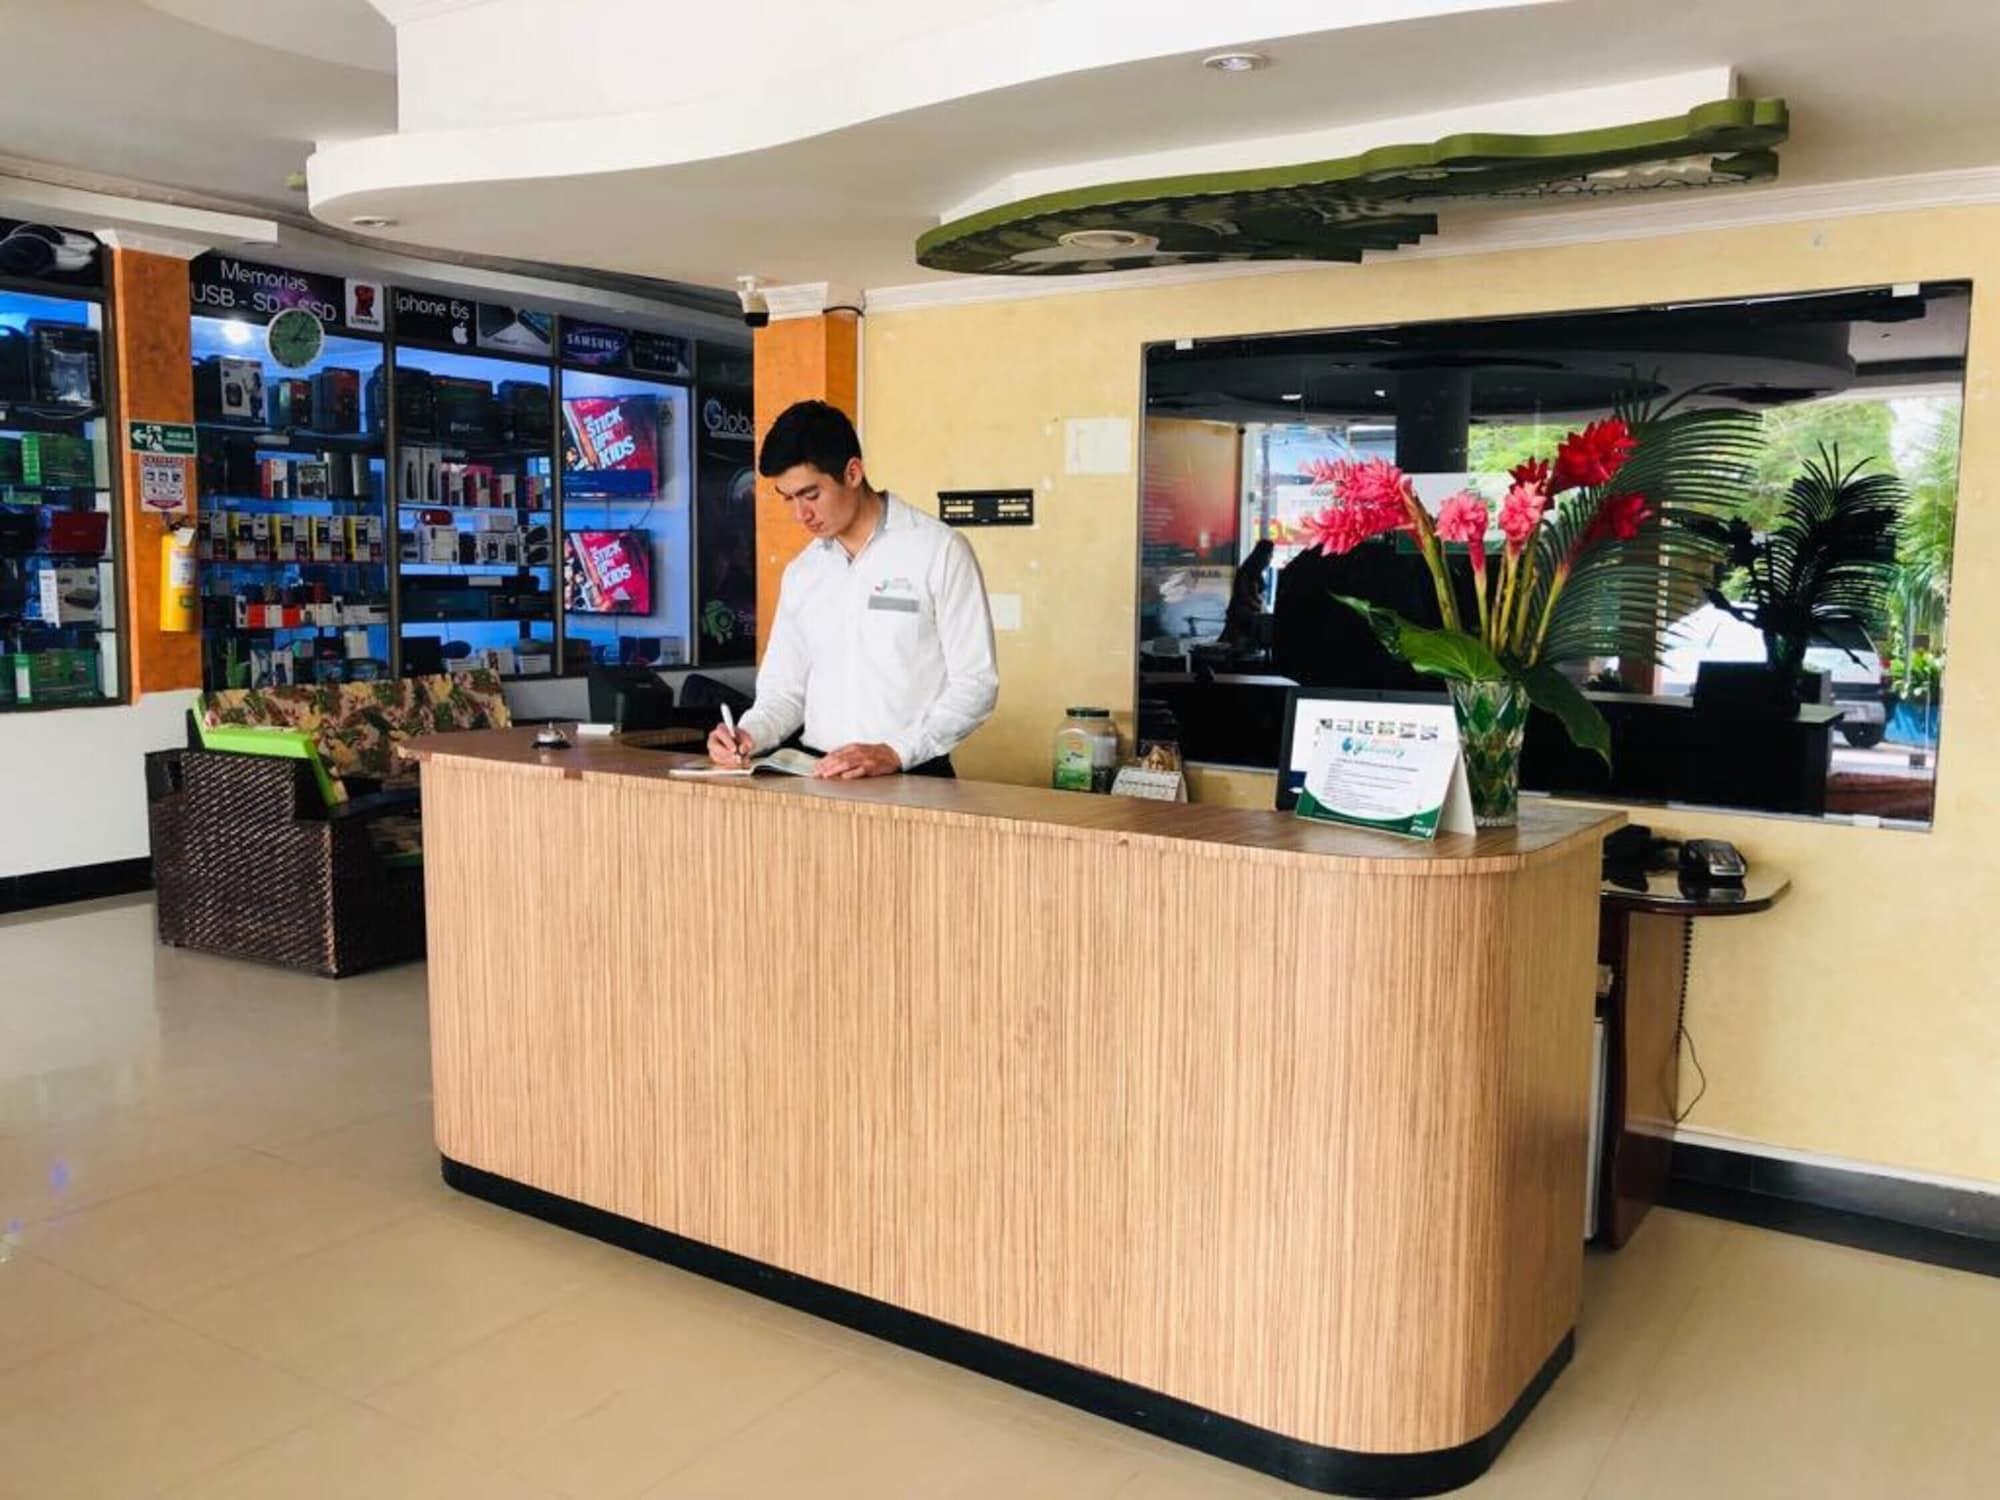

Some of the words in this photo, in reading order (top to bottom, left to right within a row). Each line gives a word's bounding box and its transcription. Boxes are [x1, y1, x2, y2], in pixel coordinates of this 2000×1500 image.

[220, 259, 309, 292] Memorias
[191, 283, 236, 308] USB
[252, 291, 281, 314] SD
[395, 290, 447, 317] Iphone
[450, 300, 470, 320] 6s
[566, 333, 620, 352] SAMSUNG
[585, 406, 624, 441] STICK
[599, 435, 636, 469] KIDS
[602, 563, 632, 590] KIDS
